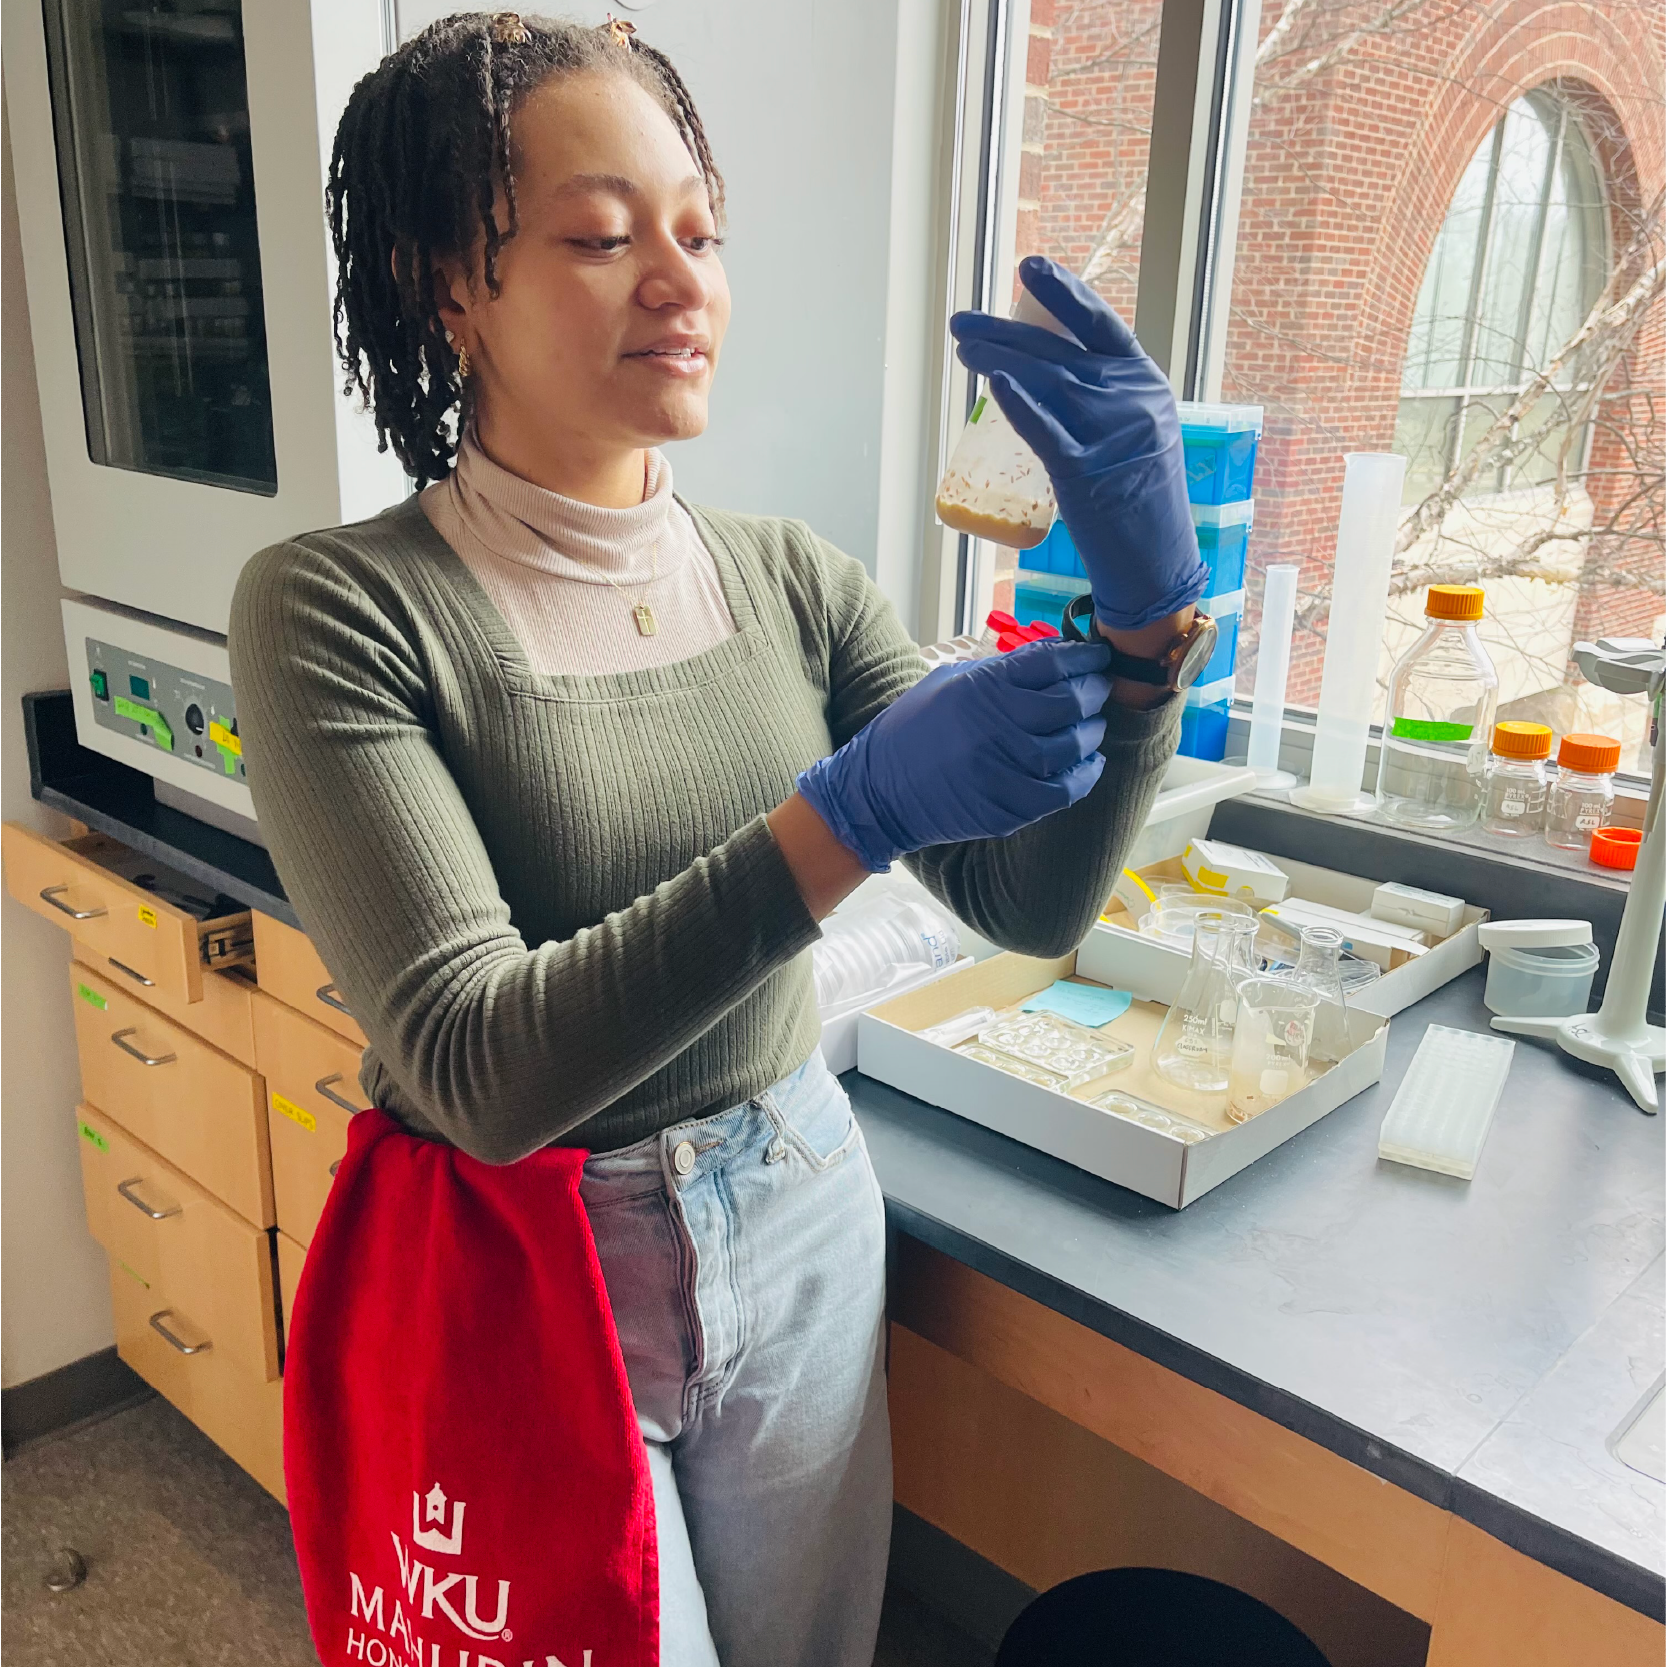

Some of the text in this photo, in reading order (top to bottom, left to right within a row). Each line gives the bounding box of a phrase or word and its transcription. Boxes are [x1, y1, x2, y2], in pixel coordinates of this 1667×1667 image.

[1579, 818, 1596, 826] ASL
[1182, 1024, 1205, 1036] KIMAX
[1265, 1053, 1281, 1061] 200
